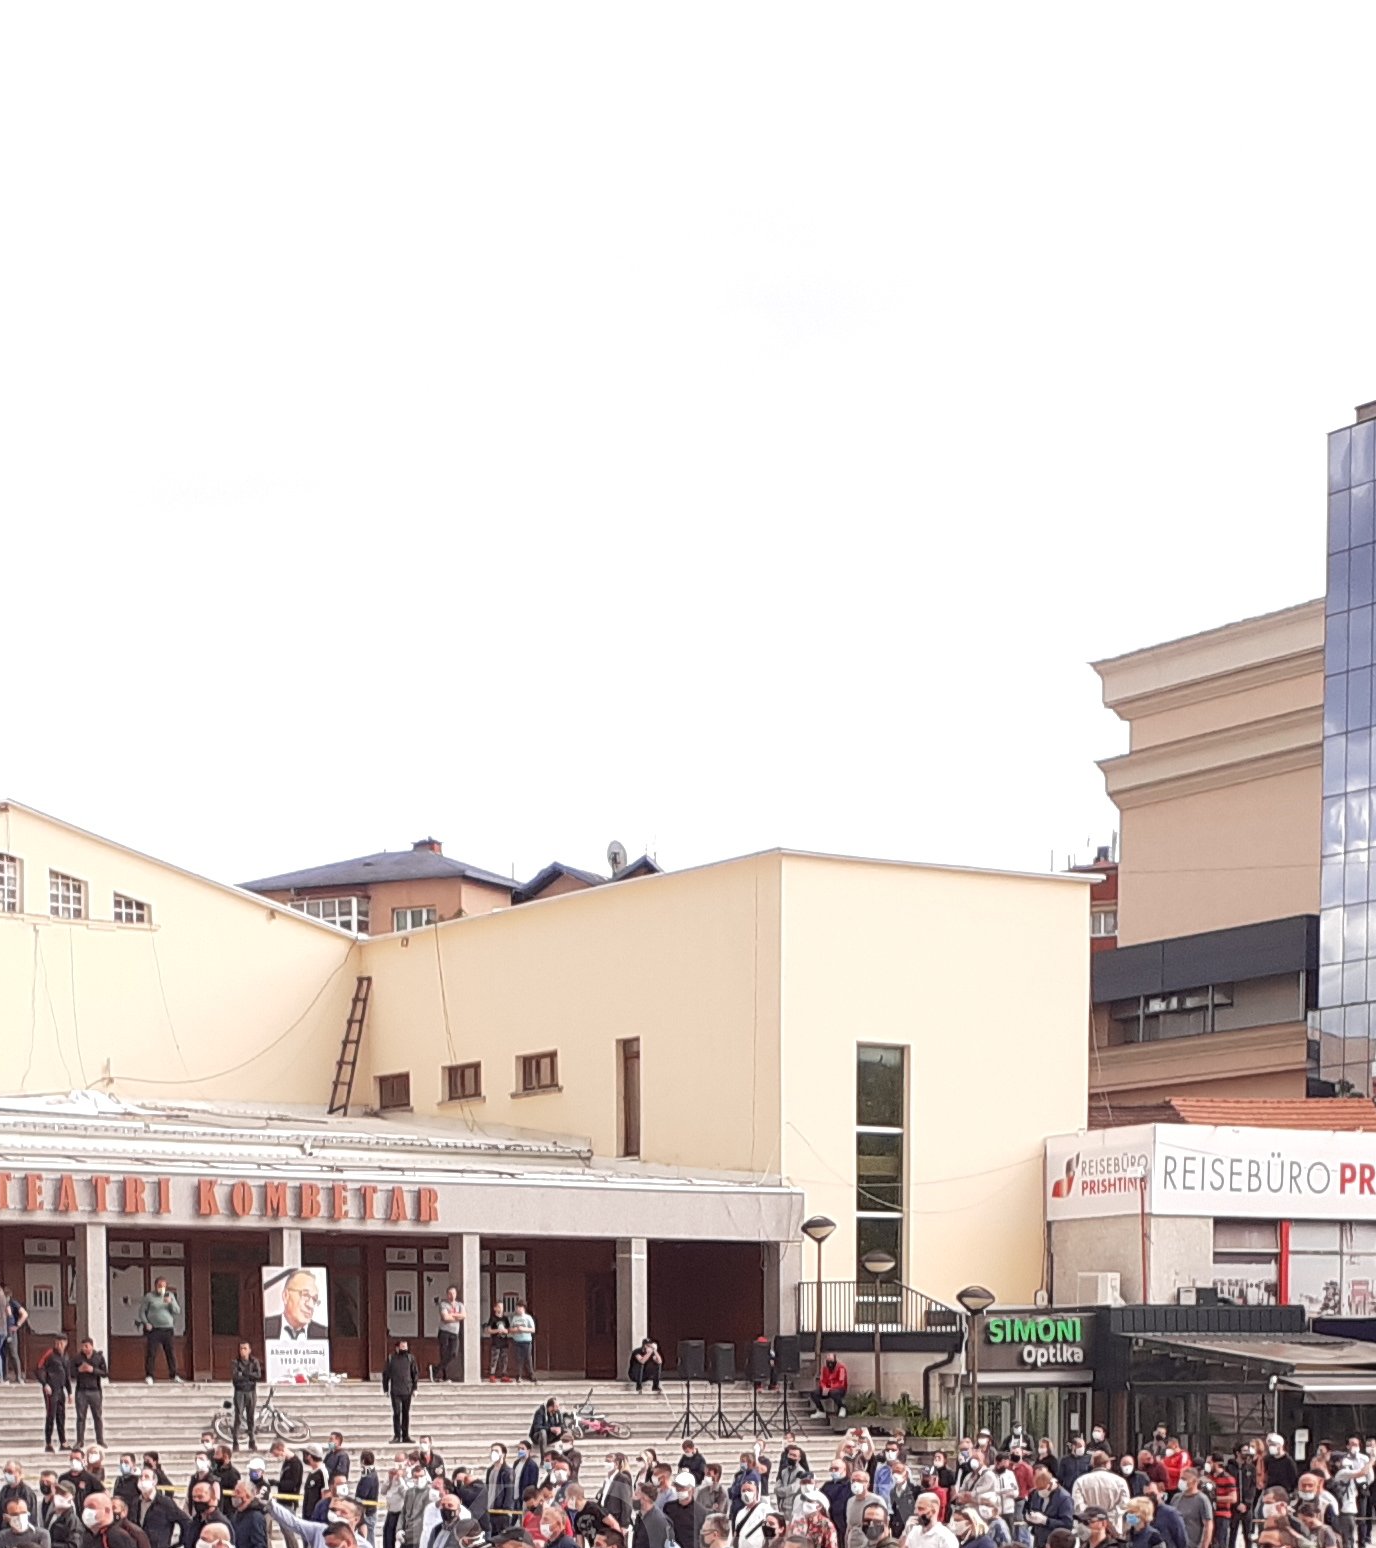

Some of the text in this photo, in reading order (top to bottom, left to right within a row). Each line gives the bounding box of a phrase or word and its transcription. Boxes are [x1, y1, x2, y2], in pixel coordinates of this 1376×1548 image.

[1163, 1152, 1330, 1194] REISEBÜRO
[989, 1317, 1081, 1343] SIMONI
[1023, 1344, 1084, 1367] Optika
